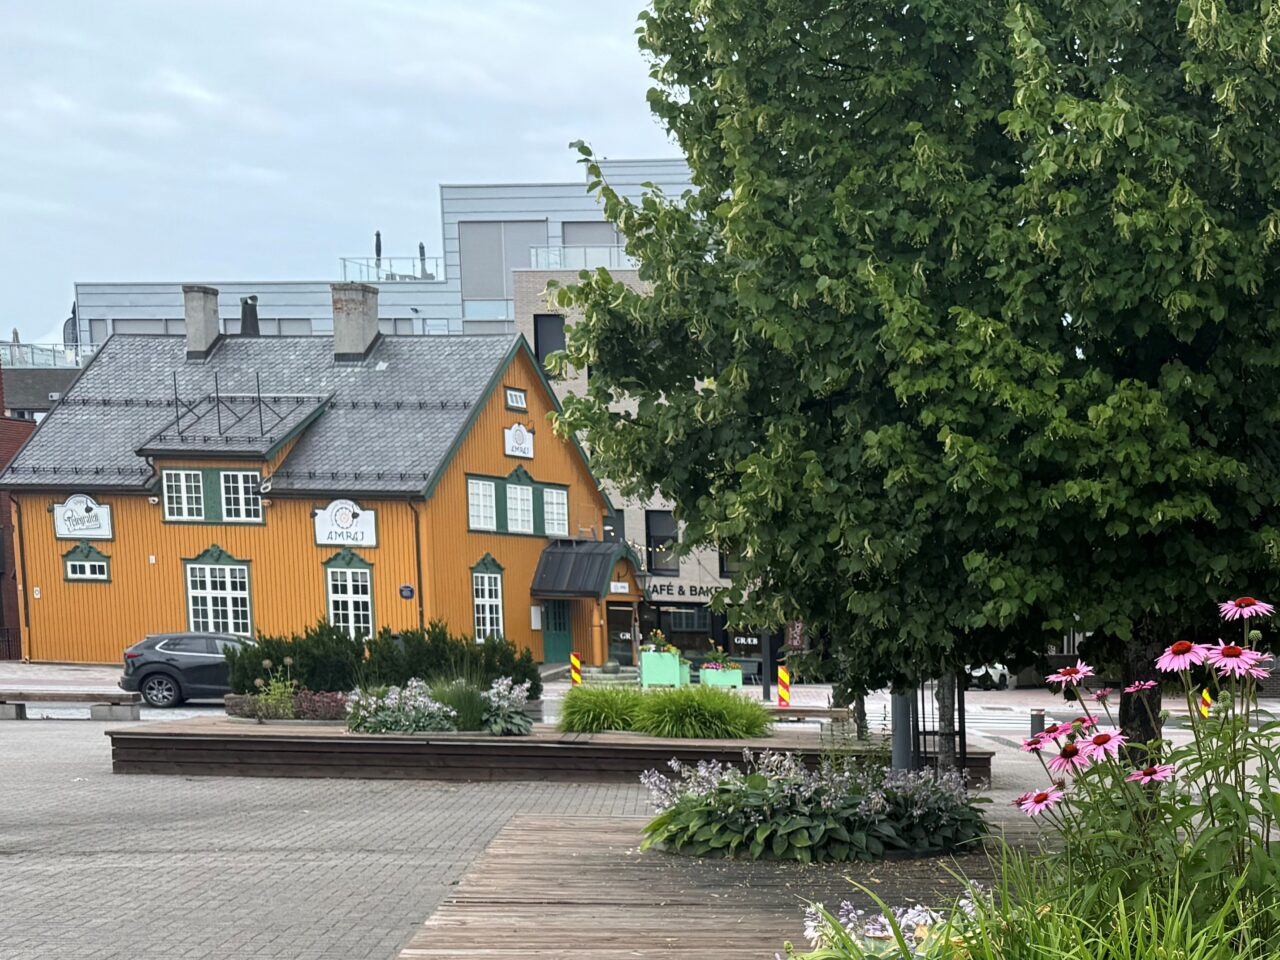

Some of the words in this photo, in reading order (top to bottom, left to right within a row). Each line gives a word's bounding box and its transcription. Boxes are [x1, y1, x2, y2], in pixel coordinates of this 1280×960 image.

[327, 531, 364, 541] AMRAJ
[648, 582, 674, 596] AFÉ
[678, 585, 686, 596] &
